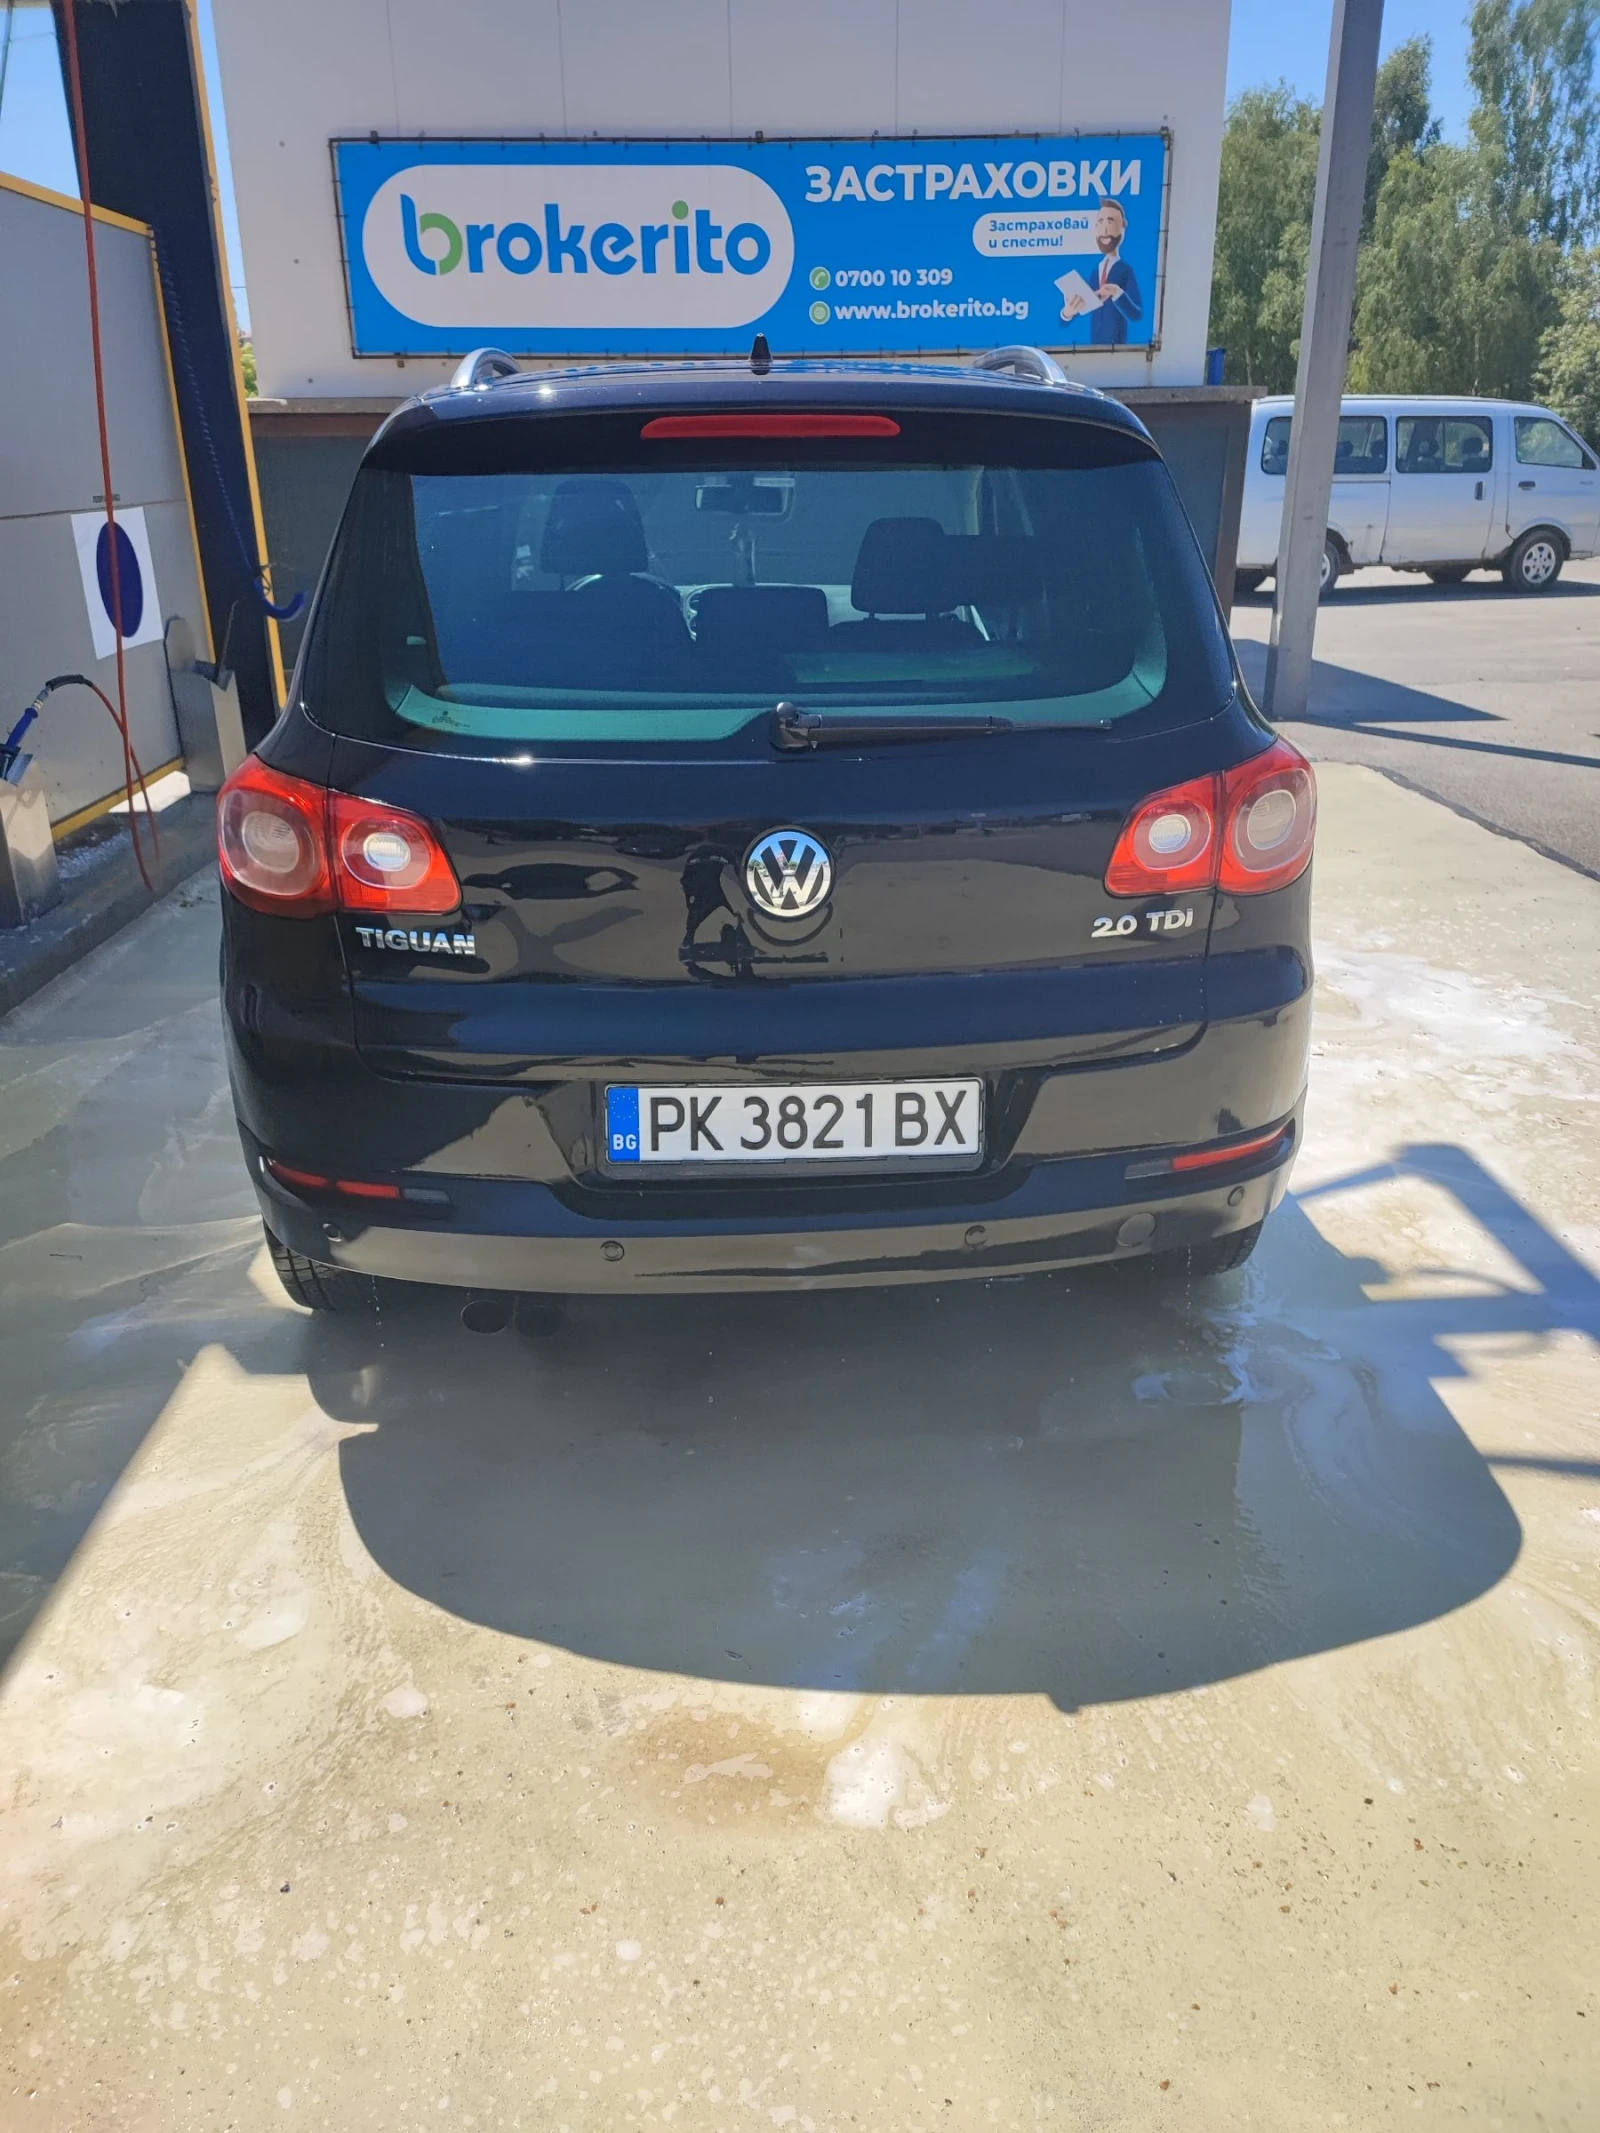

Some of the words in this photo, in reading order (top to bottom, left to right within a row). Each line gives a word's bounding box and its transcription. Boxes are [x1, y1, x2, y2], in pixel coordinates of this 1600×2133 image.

[804, 159, 1142, 203] ЗАСТРАХОВКИ
[400, 193, 771, 275] brokerito
[989, 217, 1089, 233] Застраховай
[988, 239, 998, 249] и
[1001, 235, 1064, 249] спести!
[835, 269, 886, 287] 0700
[890, 269, 911, 287] 10
[916, 268, 953, 286] 309
[834, 297, 1029, 320] www.brokerito.bg
[1146, 908, 1194, 932] TDI
[355, 927, 476, 955] TIGUAN
[649, 1096, 724, 1152] PK
[740, 1093, 874, 1150] 3821
[894, 1090, 967, 1147] BX
[612, 1134, 638, 1151] BG
